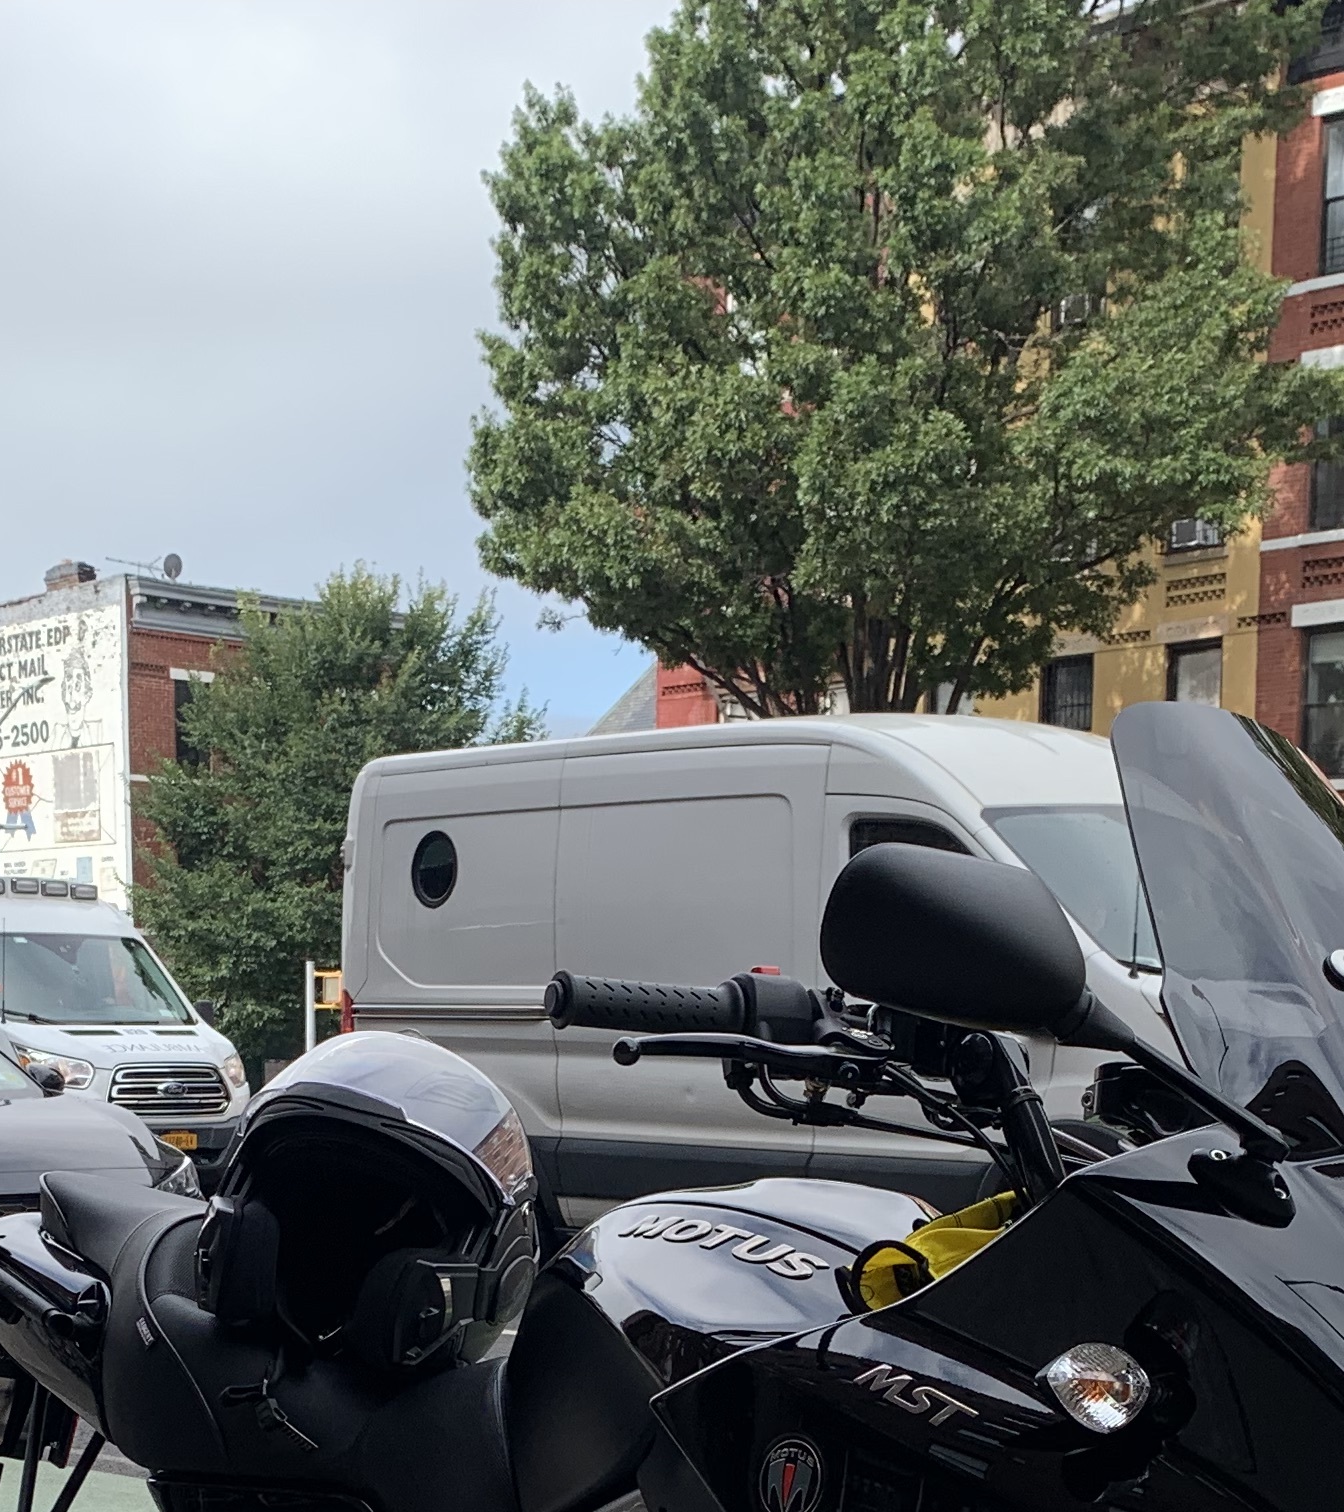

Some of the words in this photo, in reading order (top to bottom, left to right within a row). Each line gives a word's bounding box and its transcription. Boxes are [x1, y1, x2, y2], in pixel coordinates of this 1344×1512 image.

[47, 625, 72, 647] EDP
[18, 654, 48, 679] MAIL
[618, 1215, 830, 1280] MOTUS
[853, 1363, 979, 1426] MST
[770, 1448, 815, 1468] MOTUS
